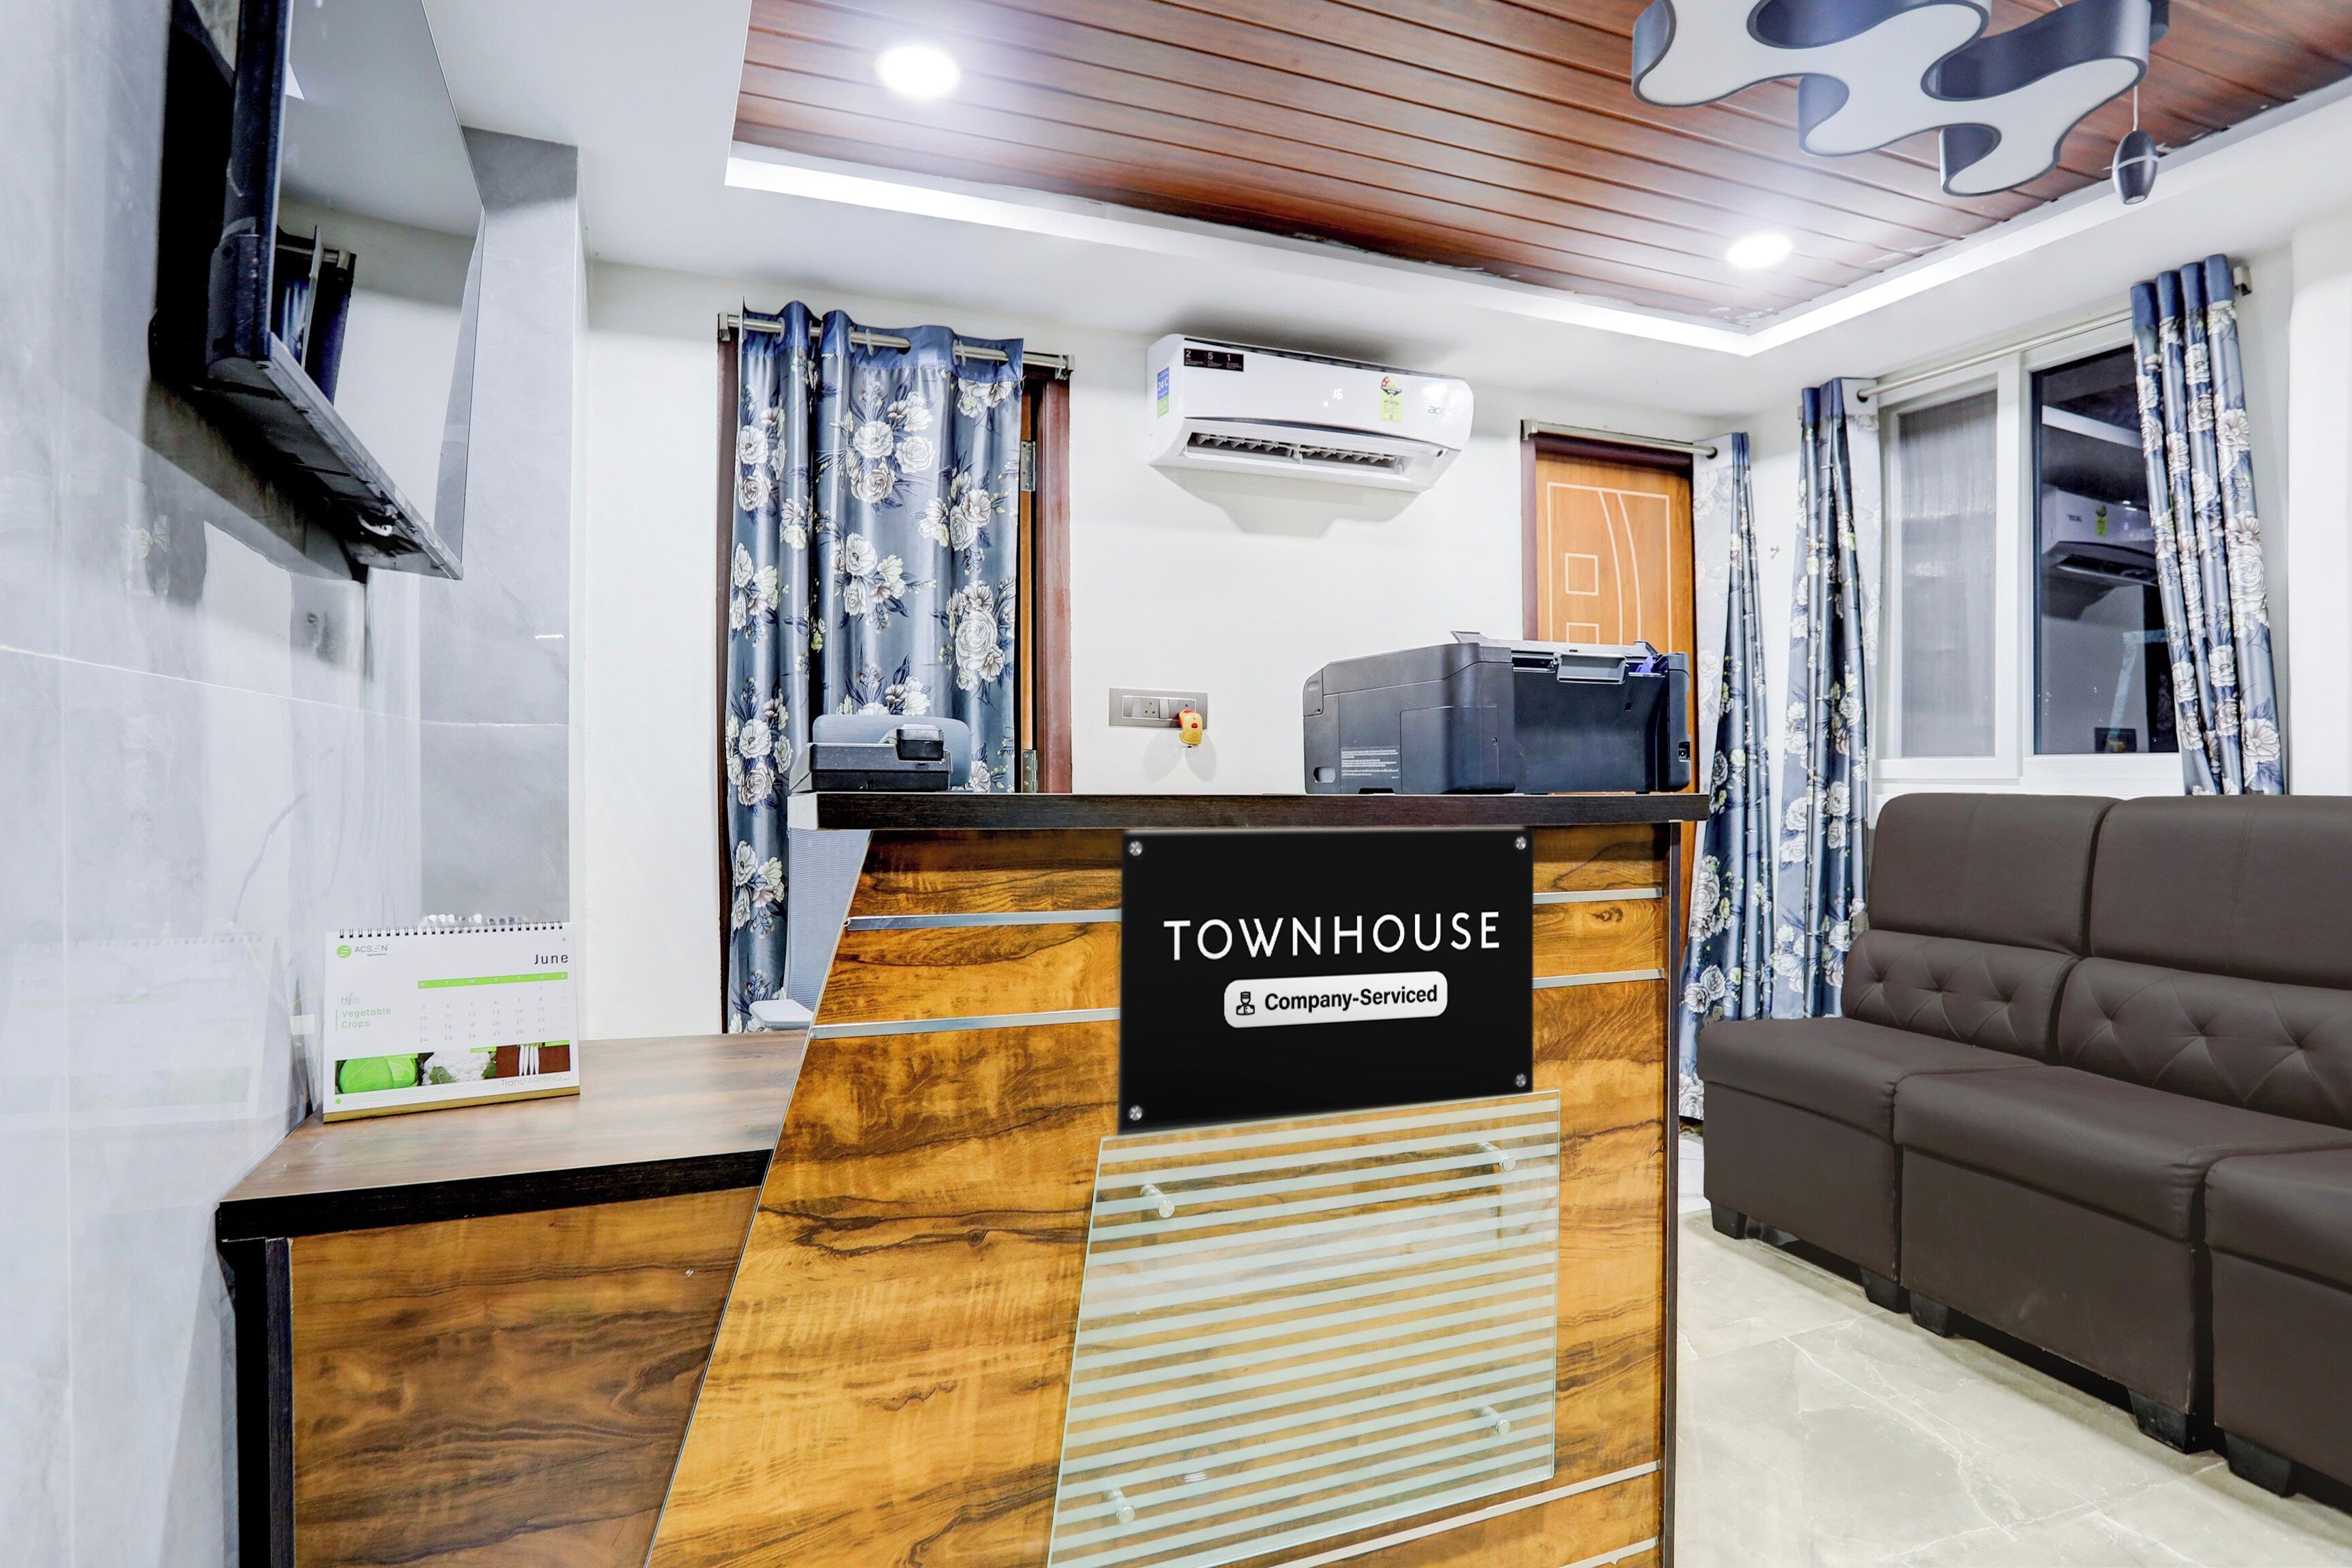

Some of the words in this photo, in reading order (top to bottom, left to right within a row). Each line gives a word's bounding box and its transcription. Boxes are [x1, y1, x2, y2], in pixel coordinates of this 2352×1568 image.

[1185, 349, 1192, 358] 2
[1333, 388, 1343, 400] 16
[1163, 911, 1501, 961] TOWNHOUSE
[534, 954, 568, 965] June
[1264, 984, 1438, 1013] Company-Serviced
[342, 1007, 391, 1018] Vegetable
[342, 1020, 370, 1029] Crops
[500, 1074, 562, 1087] TransFARMING
